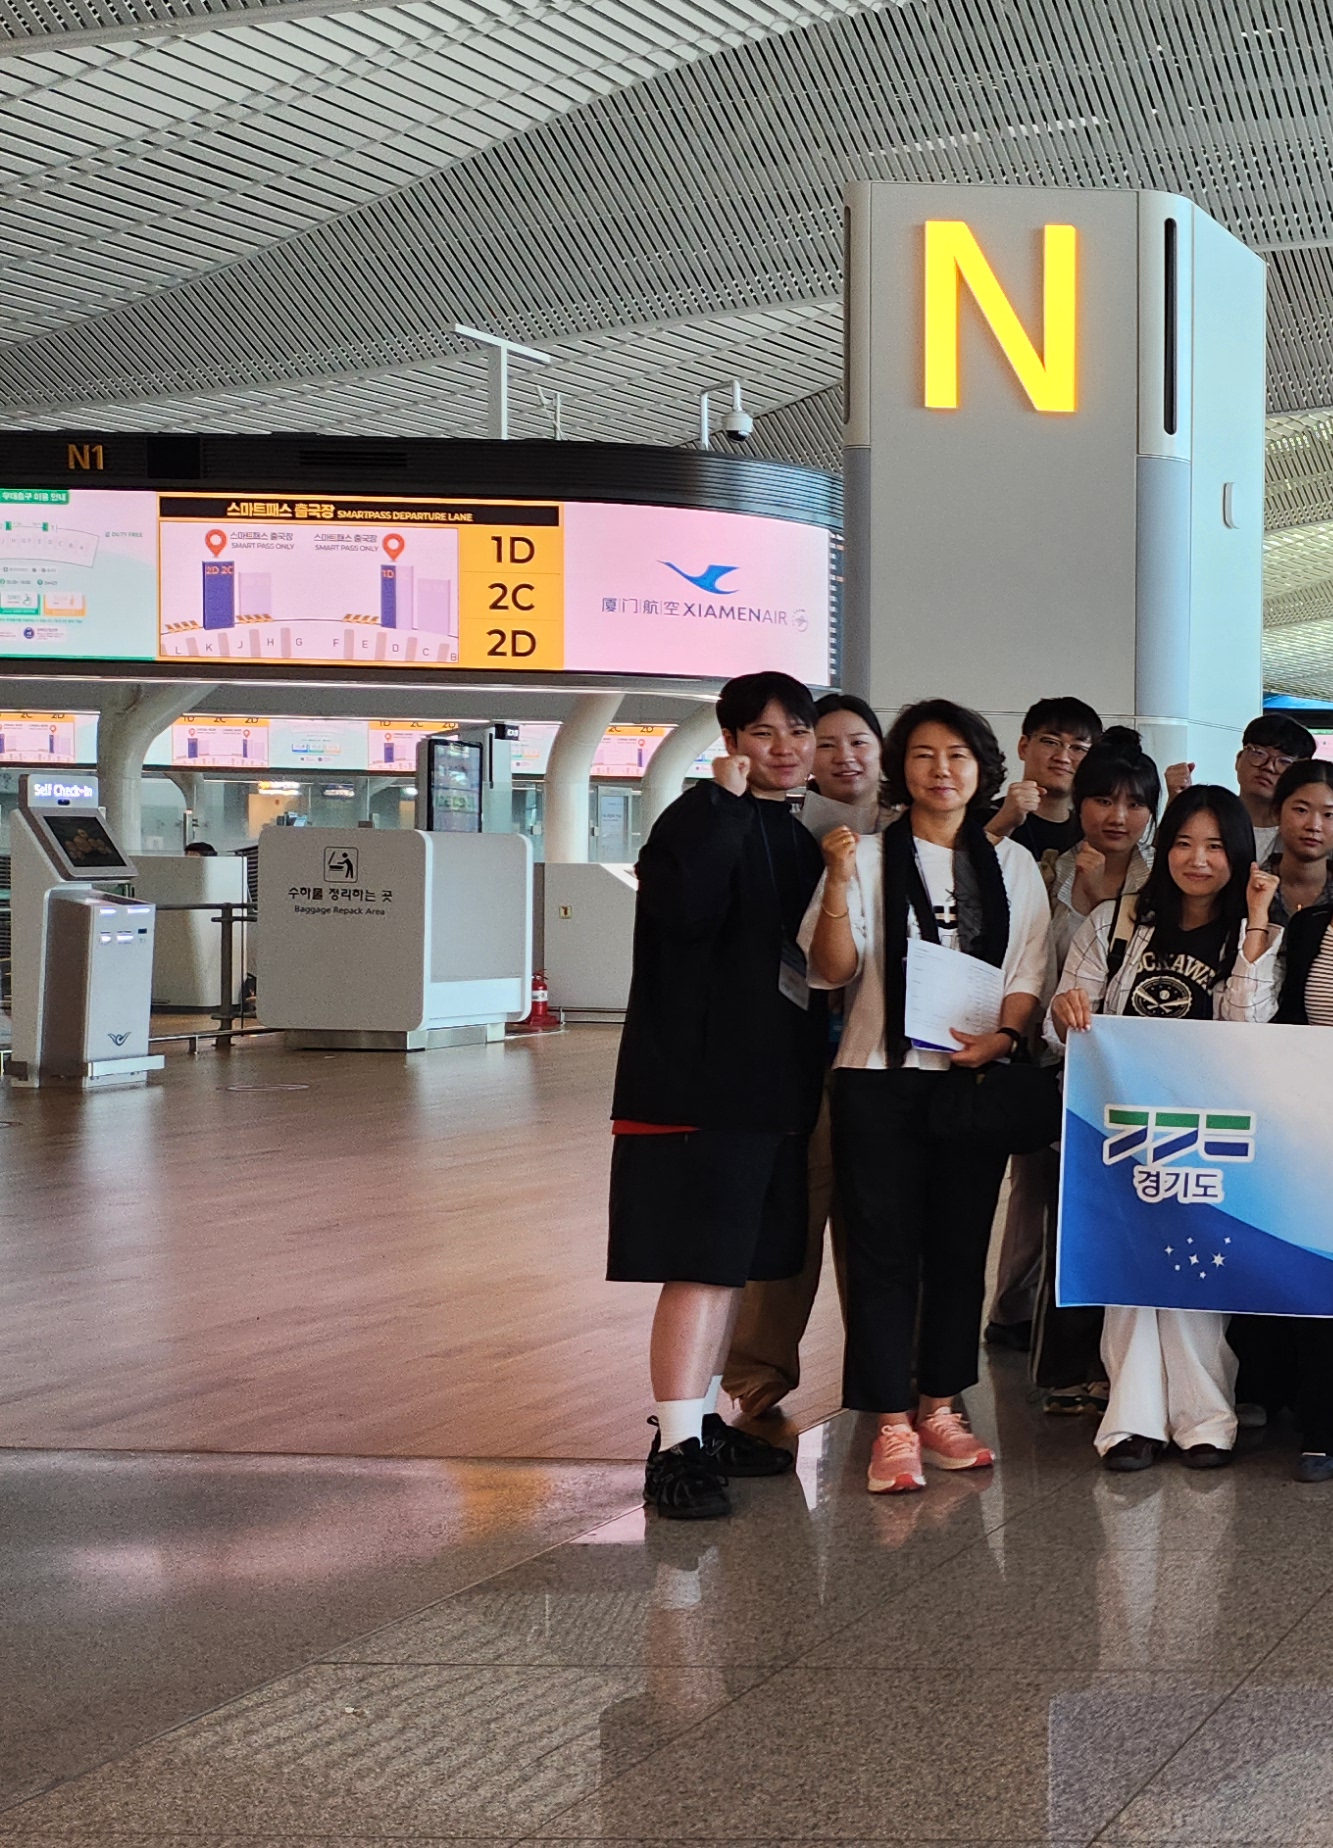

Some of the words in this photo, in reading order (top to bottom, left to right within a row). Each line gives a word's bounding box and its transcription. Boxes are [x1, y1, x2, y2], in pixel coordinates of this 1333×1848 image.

[924, 220, 1076, 412] N
[67, 444, 104, 470] N1
[227, 502, 292, 517] 스마트패스
[295, 502, 335, 518] 출국장
[337, 510, 392, 520] SMARTPASS
[393, 512, 447, 521] DEPARTURE
[448, 513, 473, 522] LANE
[230, 532, 268, 540] 스마트패스
[314, 534, 352, 542] 스마트패스
[490, 536, 535, 564] 1D
[488, 582, 535, 612] 2C
[602, 598, 680, 616] 厦门航空
[683, 602, 788, 625] XIAMENAIR
[486, 629, 536, 657] 2D
[34, 784, 52, 796] Self
[54, 784, 93, 797] Check-in
[288, 887, 323, 900] 수하물
[329, 888, 376, 902] 정리하는
[382, 890, 392, 902] 곳
[295, 905, 331, 915] Baggage
[333, 906, 363, 915] Repack
[1138, 1171, 1218, 1198] 경기도
